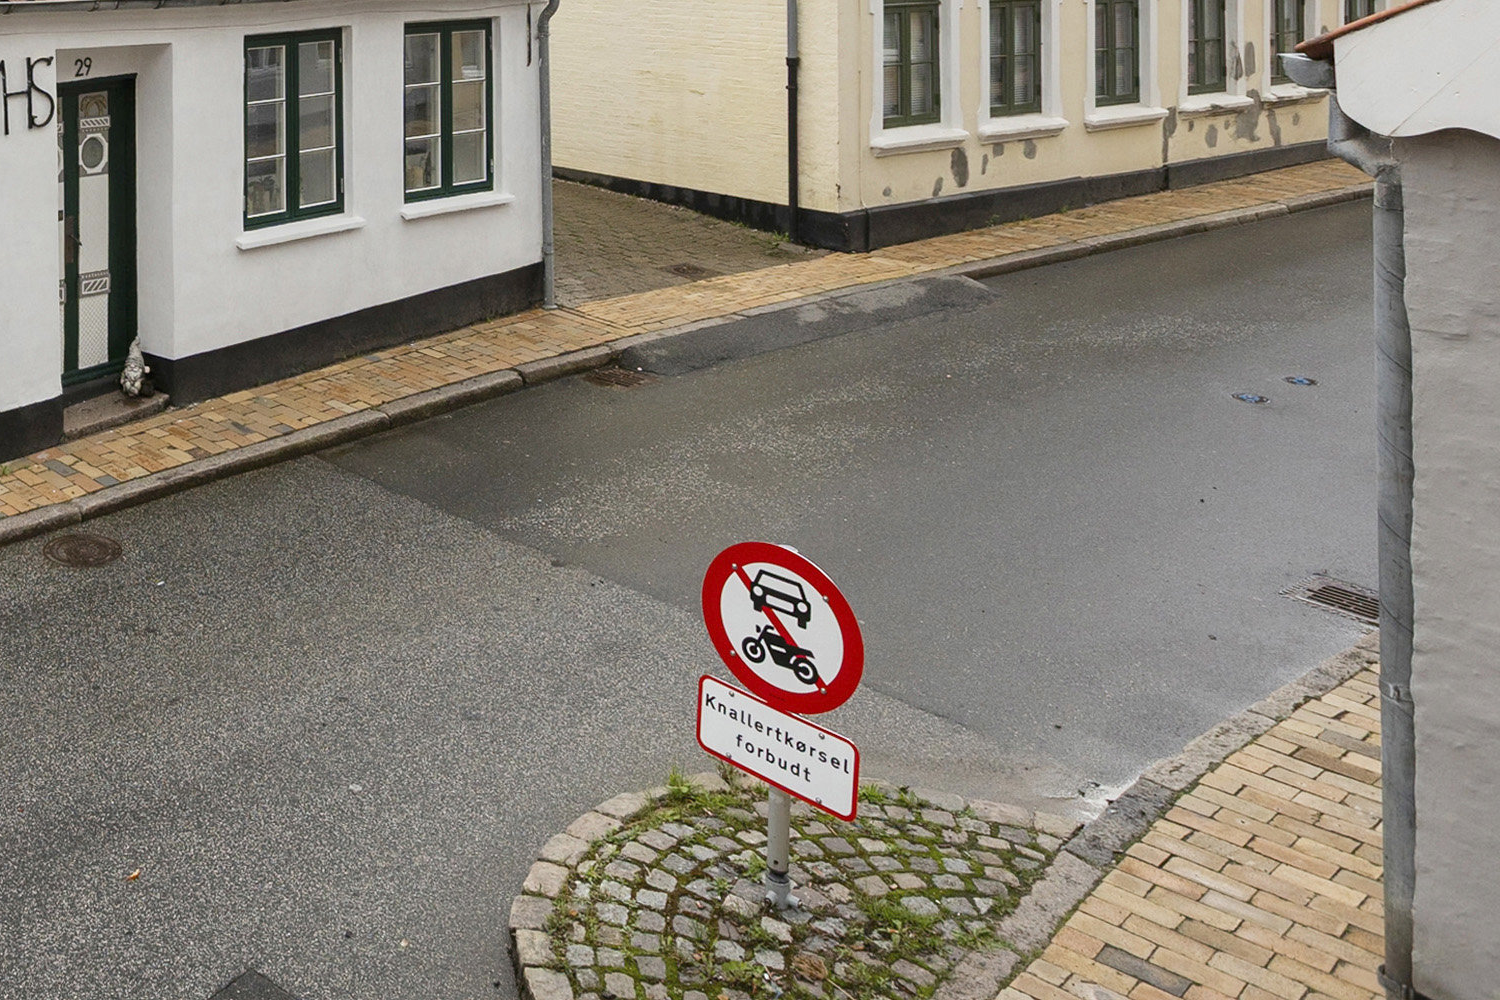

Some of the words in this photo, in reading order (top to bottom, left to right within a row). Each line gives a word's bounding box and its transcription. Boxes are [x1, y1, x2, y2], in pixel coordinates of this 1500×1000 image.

[74, 57, 92, 77] 29
[705, 693, 850, 774] Knallertkørsel
[736, 734, 811, 782] forbudt
